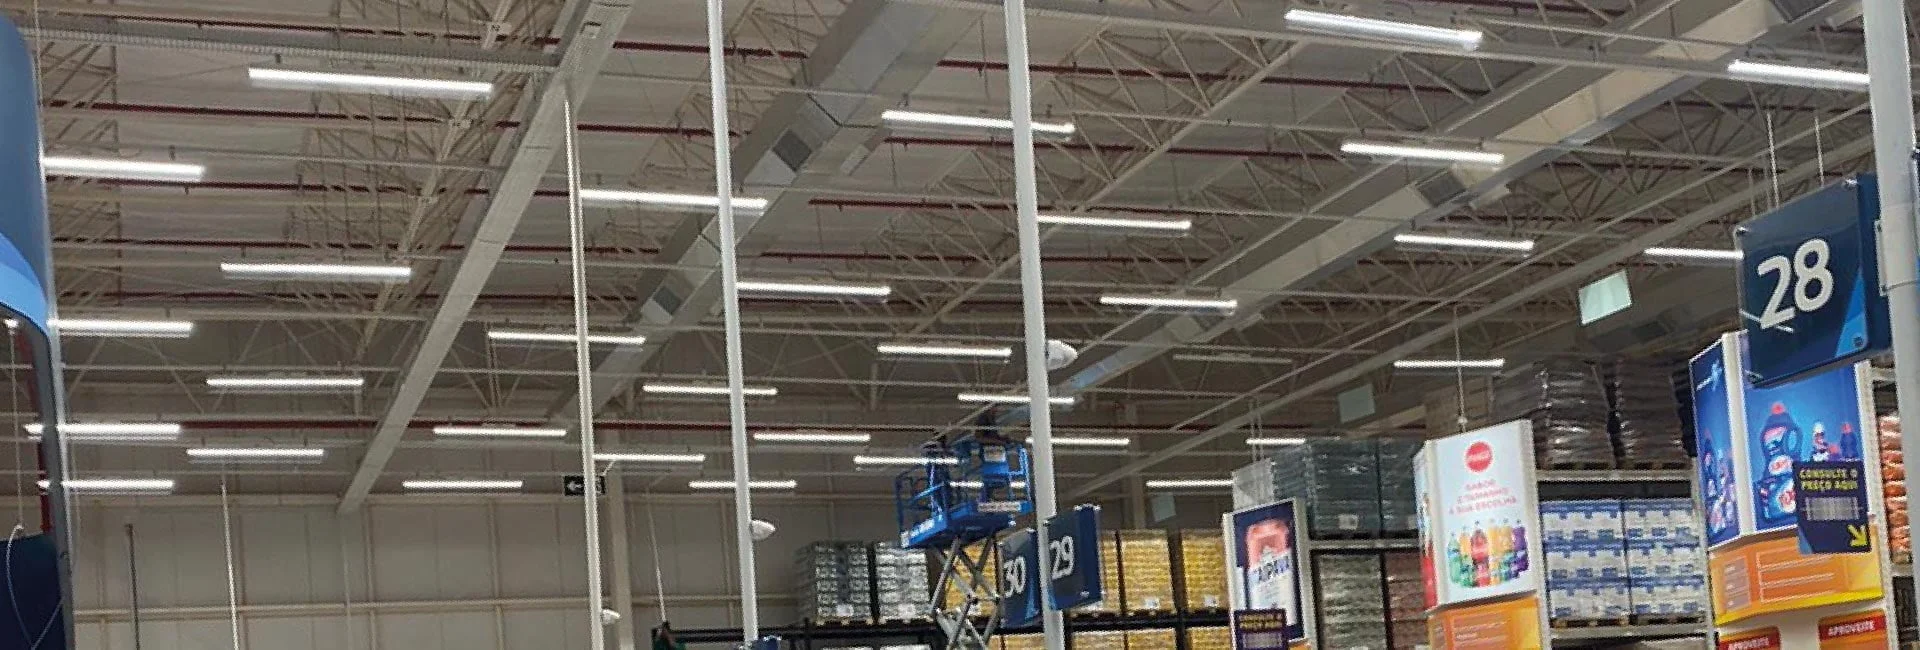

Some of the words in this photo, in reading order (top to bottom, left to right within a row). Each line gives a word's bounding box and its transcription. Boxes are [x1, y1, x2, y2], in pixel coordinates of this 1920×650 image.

[1757, 238, 1834, 329] 28
[1003, 556, 1026, 598] 30
[1049, 535, 1074, 580] 29
[1828, 620, 1875, 637] APROVEITE
